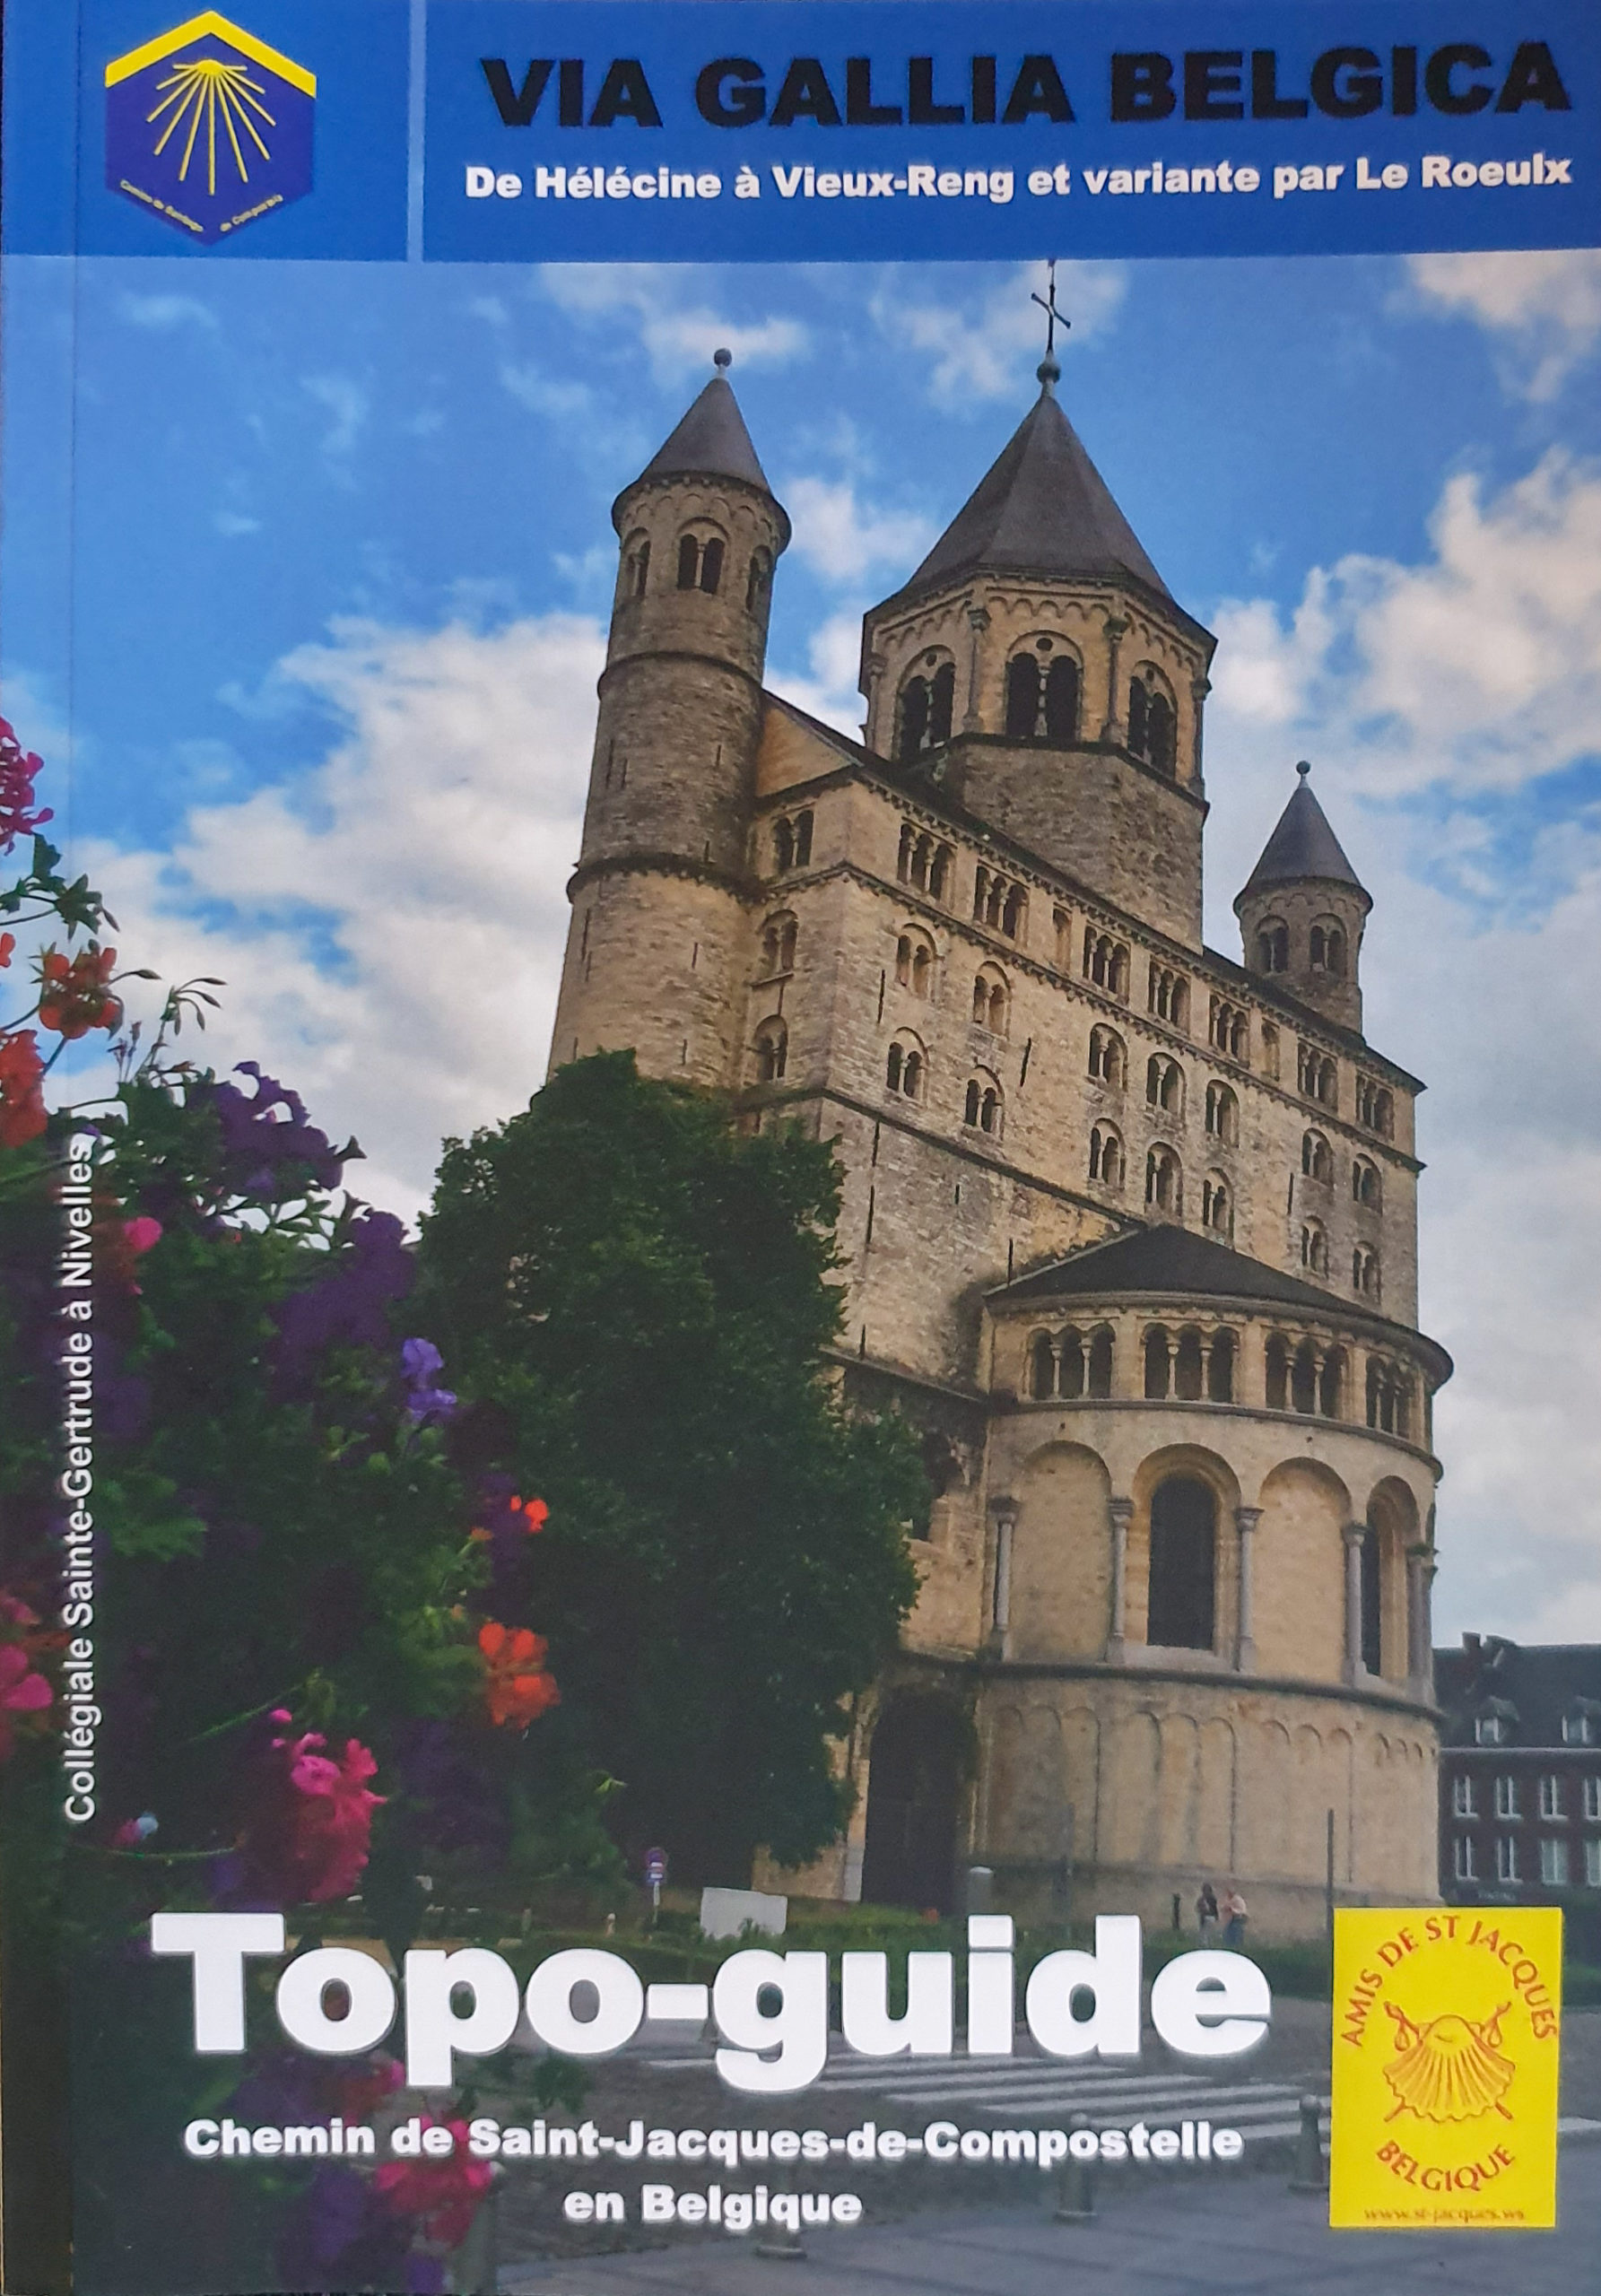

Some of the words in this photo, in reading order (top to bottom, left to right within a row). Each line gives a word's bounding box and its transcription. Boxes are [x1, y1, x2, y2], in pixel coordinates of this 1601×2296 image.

[480, 57, 664, 128] VIA
[696, 53, 1076, 127] GALLIA
[1110, 40, 1572, 122] BELGICA
[466, 166, 522, 199] De
[535, 164, 722, 199] Hélécine
[735, 165, 761, 199] à
[771, 164, 1014, 204] Vieux-Reng
[1028, 163, 1071, 196] et
[1082, 160, 1260, 196] variante
[1274, 163, 1344, 199] par
[1356, 156, 1409, 191] Le
[1422, 153, 1572, 188] Roeulx
[61, 1133, 92, 1287] Nivelles
[60, 1300, 92, 1321] à
[61, 1331, 93, 1628] Sainte-Gertrude
[64, 1638, 102, 1822] Collégiale
[150, 1912, 1272, 2092] Topo-guide
[1341, 1968, 1383, 2048] AMIS
[1377, 1926, 1420, 1968] DE
[1424, 1914, 1461, 1942] ST
[1466, 1919, 1558, 2040] JACQUES
[184, 2118, 376, 2157] Chemin
[390, 2117, 453, 2156] de
[467, 2118, 1245, 2169] Saint-Jacques-de-Compostelle
[1375, 2139, 1516, 2192] BELGIQUE
[563, 2189, 626, 2222] en
[641, 2183, 863, 2232] Belgique
